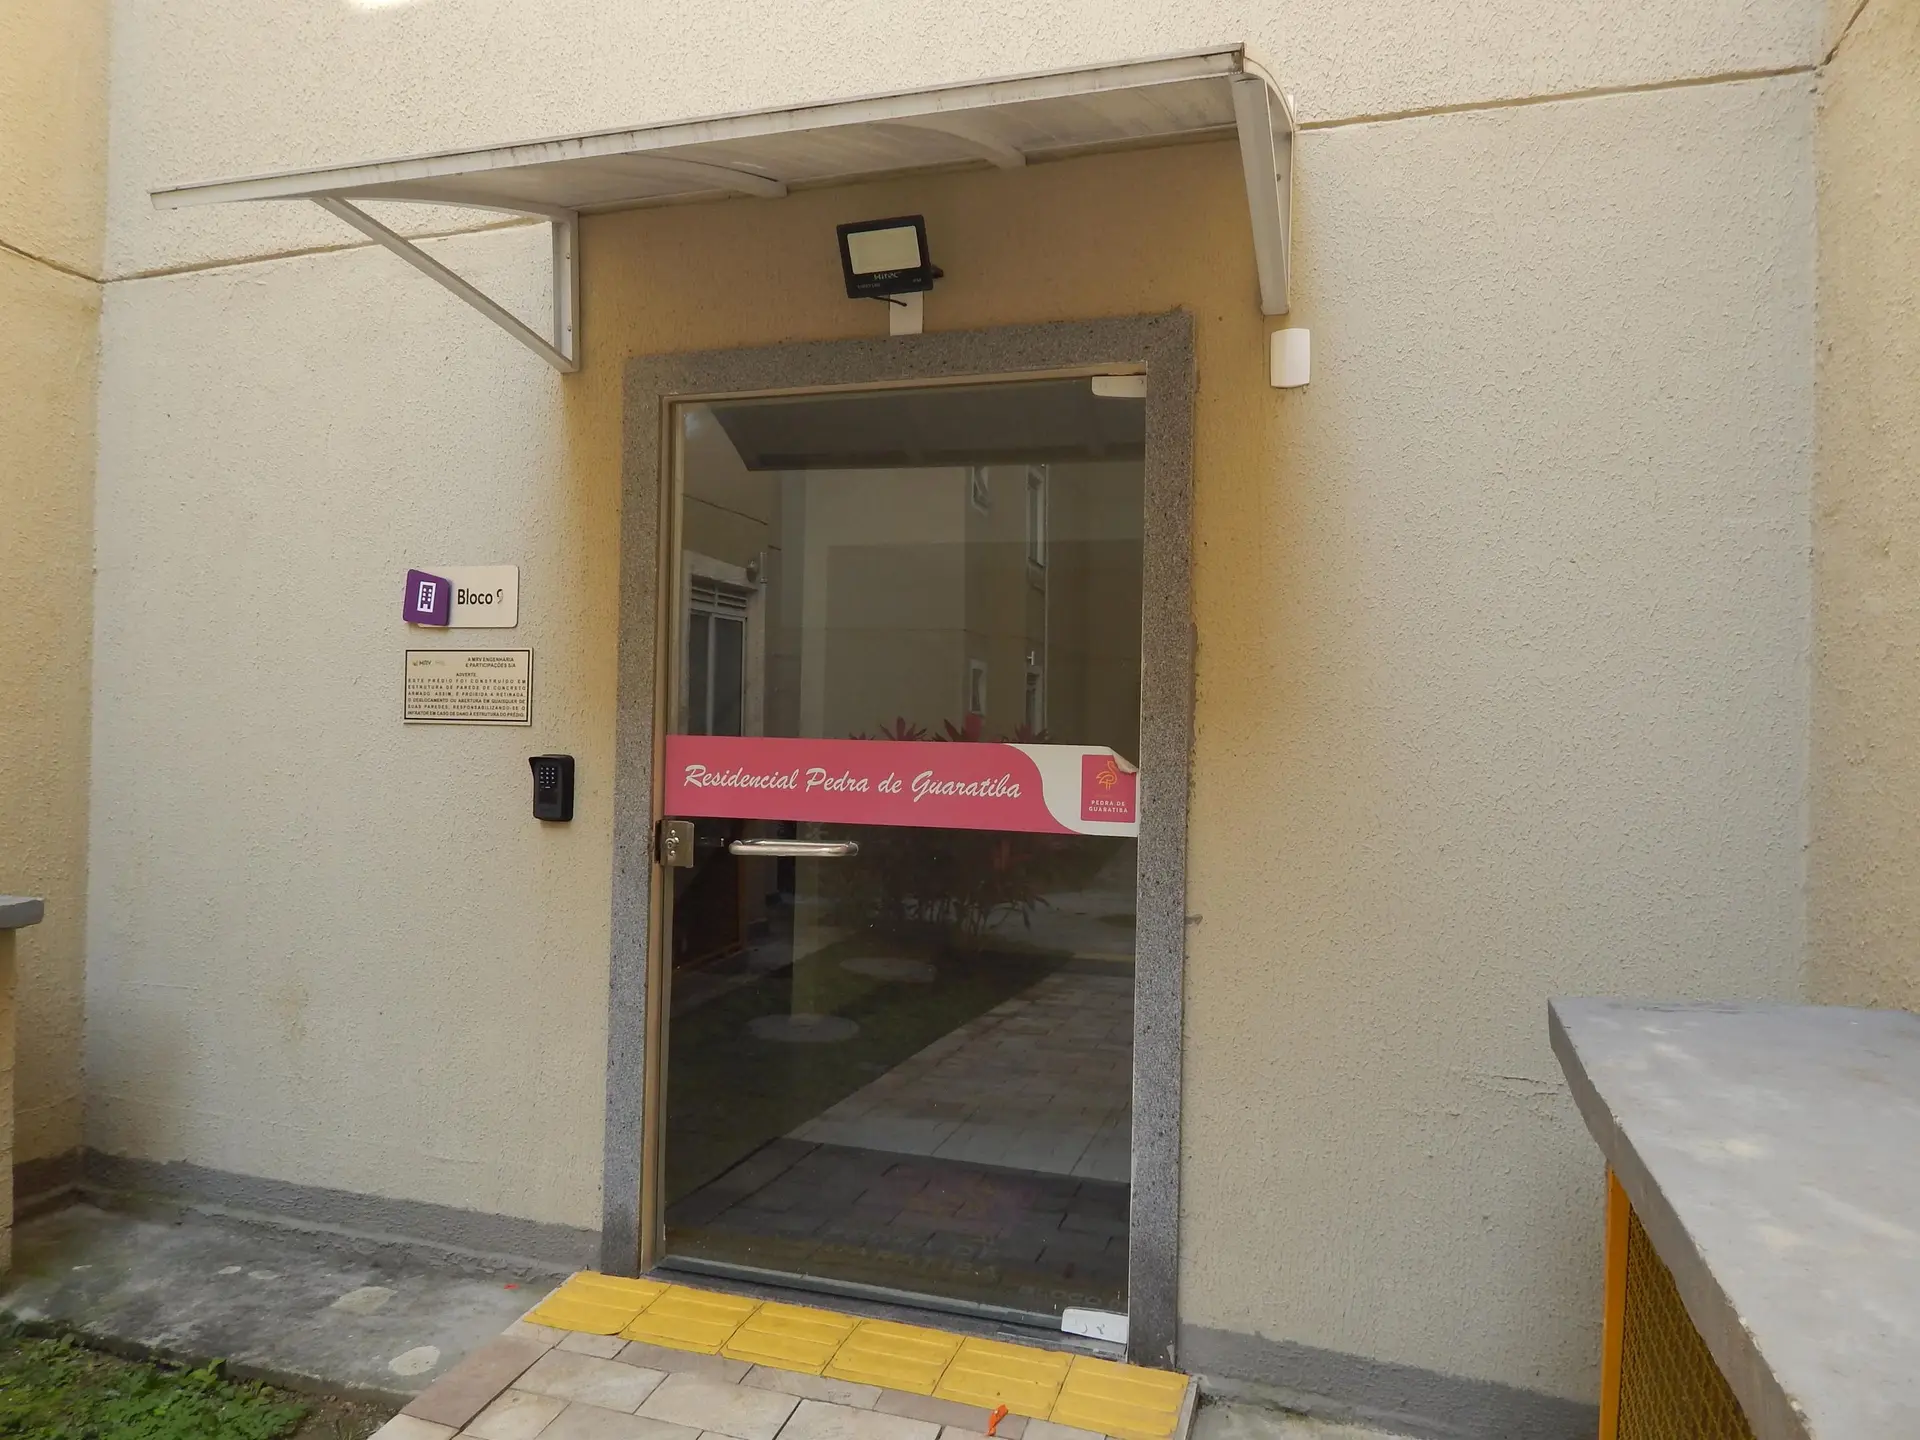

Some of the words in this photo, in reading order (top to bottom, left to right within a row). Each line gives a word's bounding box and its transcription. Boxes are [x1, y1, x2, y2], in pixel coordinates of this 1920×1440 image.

[457, 589, 493, 605] Bloco
[684, 764, 800, 790] Residencial
[805, 767, 870, 793] Pedra
[877, 772, 905, 795] de
[911, 772, 1022, 803] Guaratiba
